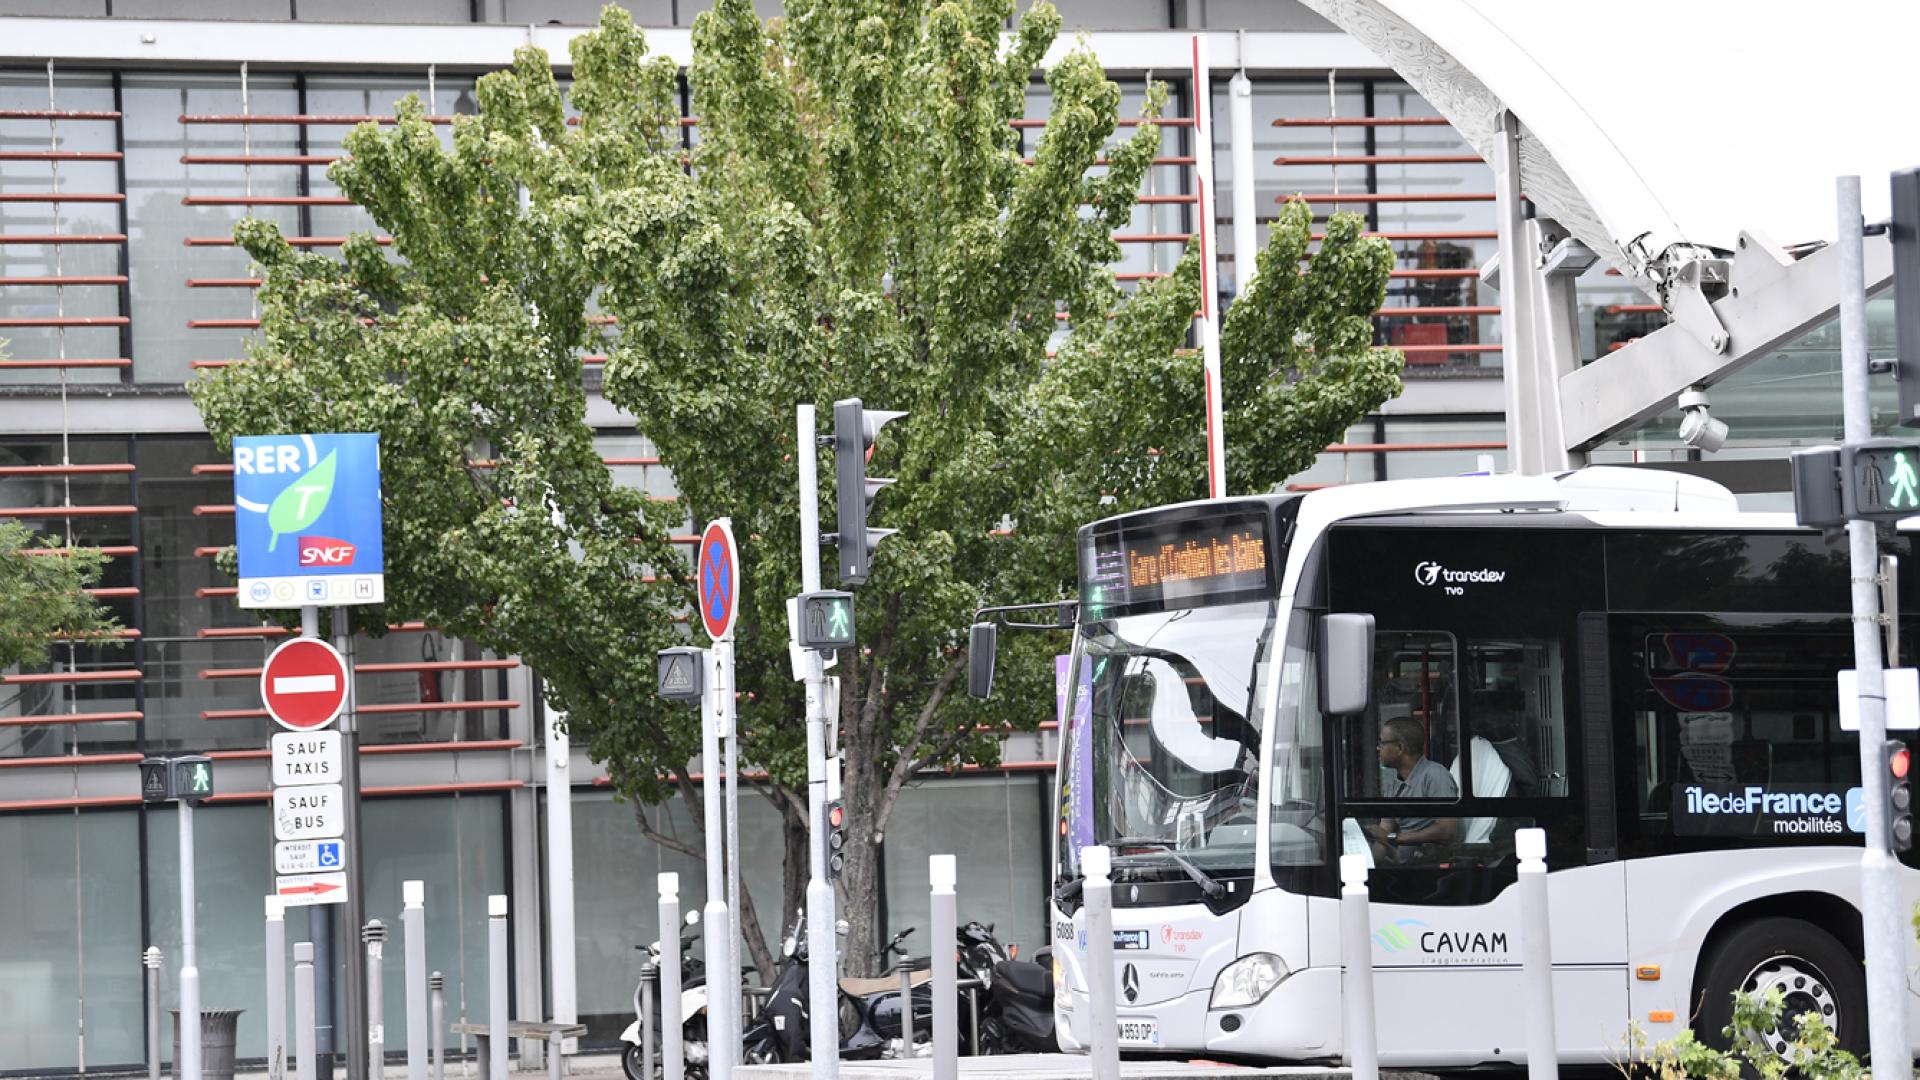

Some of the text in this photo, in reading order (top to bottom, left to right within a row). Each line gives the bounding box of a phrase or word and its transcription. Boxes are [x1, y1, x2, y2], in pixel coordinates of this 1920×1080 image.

[234, 445, 301, 475] RER
[294, 485, 327, 521] T
[300, 546, 353, 564] SNCF
[1442, 568, 1506, 582] transdev
[360, 583, 368, 594] H
[1443, 586, 1464, 595] TVO
[286, 741, 327, 755] SAUF
[285, 761, 329, 775] TAXIS
[288, 795, 328, 809] SAUF
[1684, 786, 1842, 814] îledeFrance
[294, 815, 324, 829] BUS
[1774, 815, 1842, 834] mobilités
[1056, 921, 1074, 940] 6088
[1420, 931, 1508, 953] CAVAM
[1124, 1023, 1140, 1040] 853
[1140, 1023, 1152, 1040] DP
